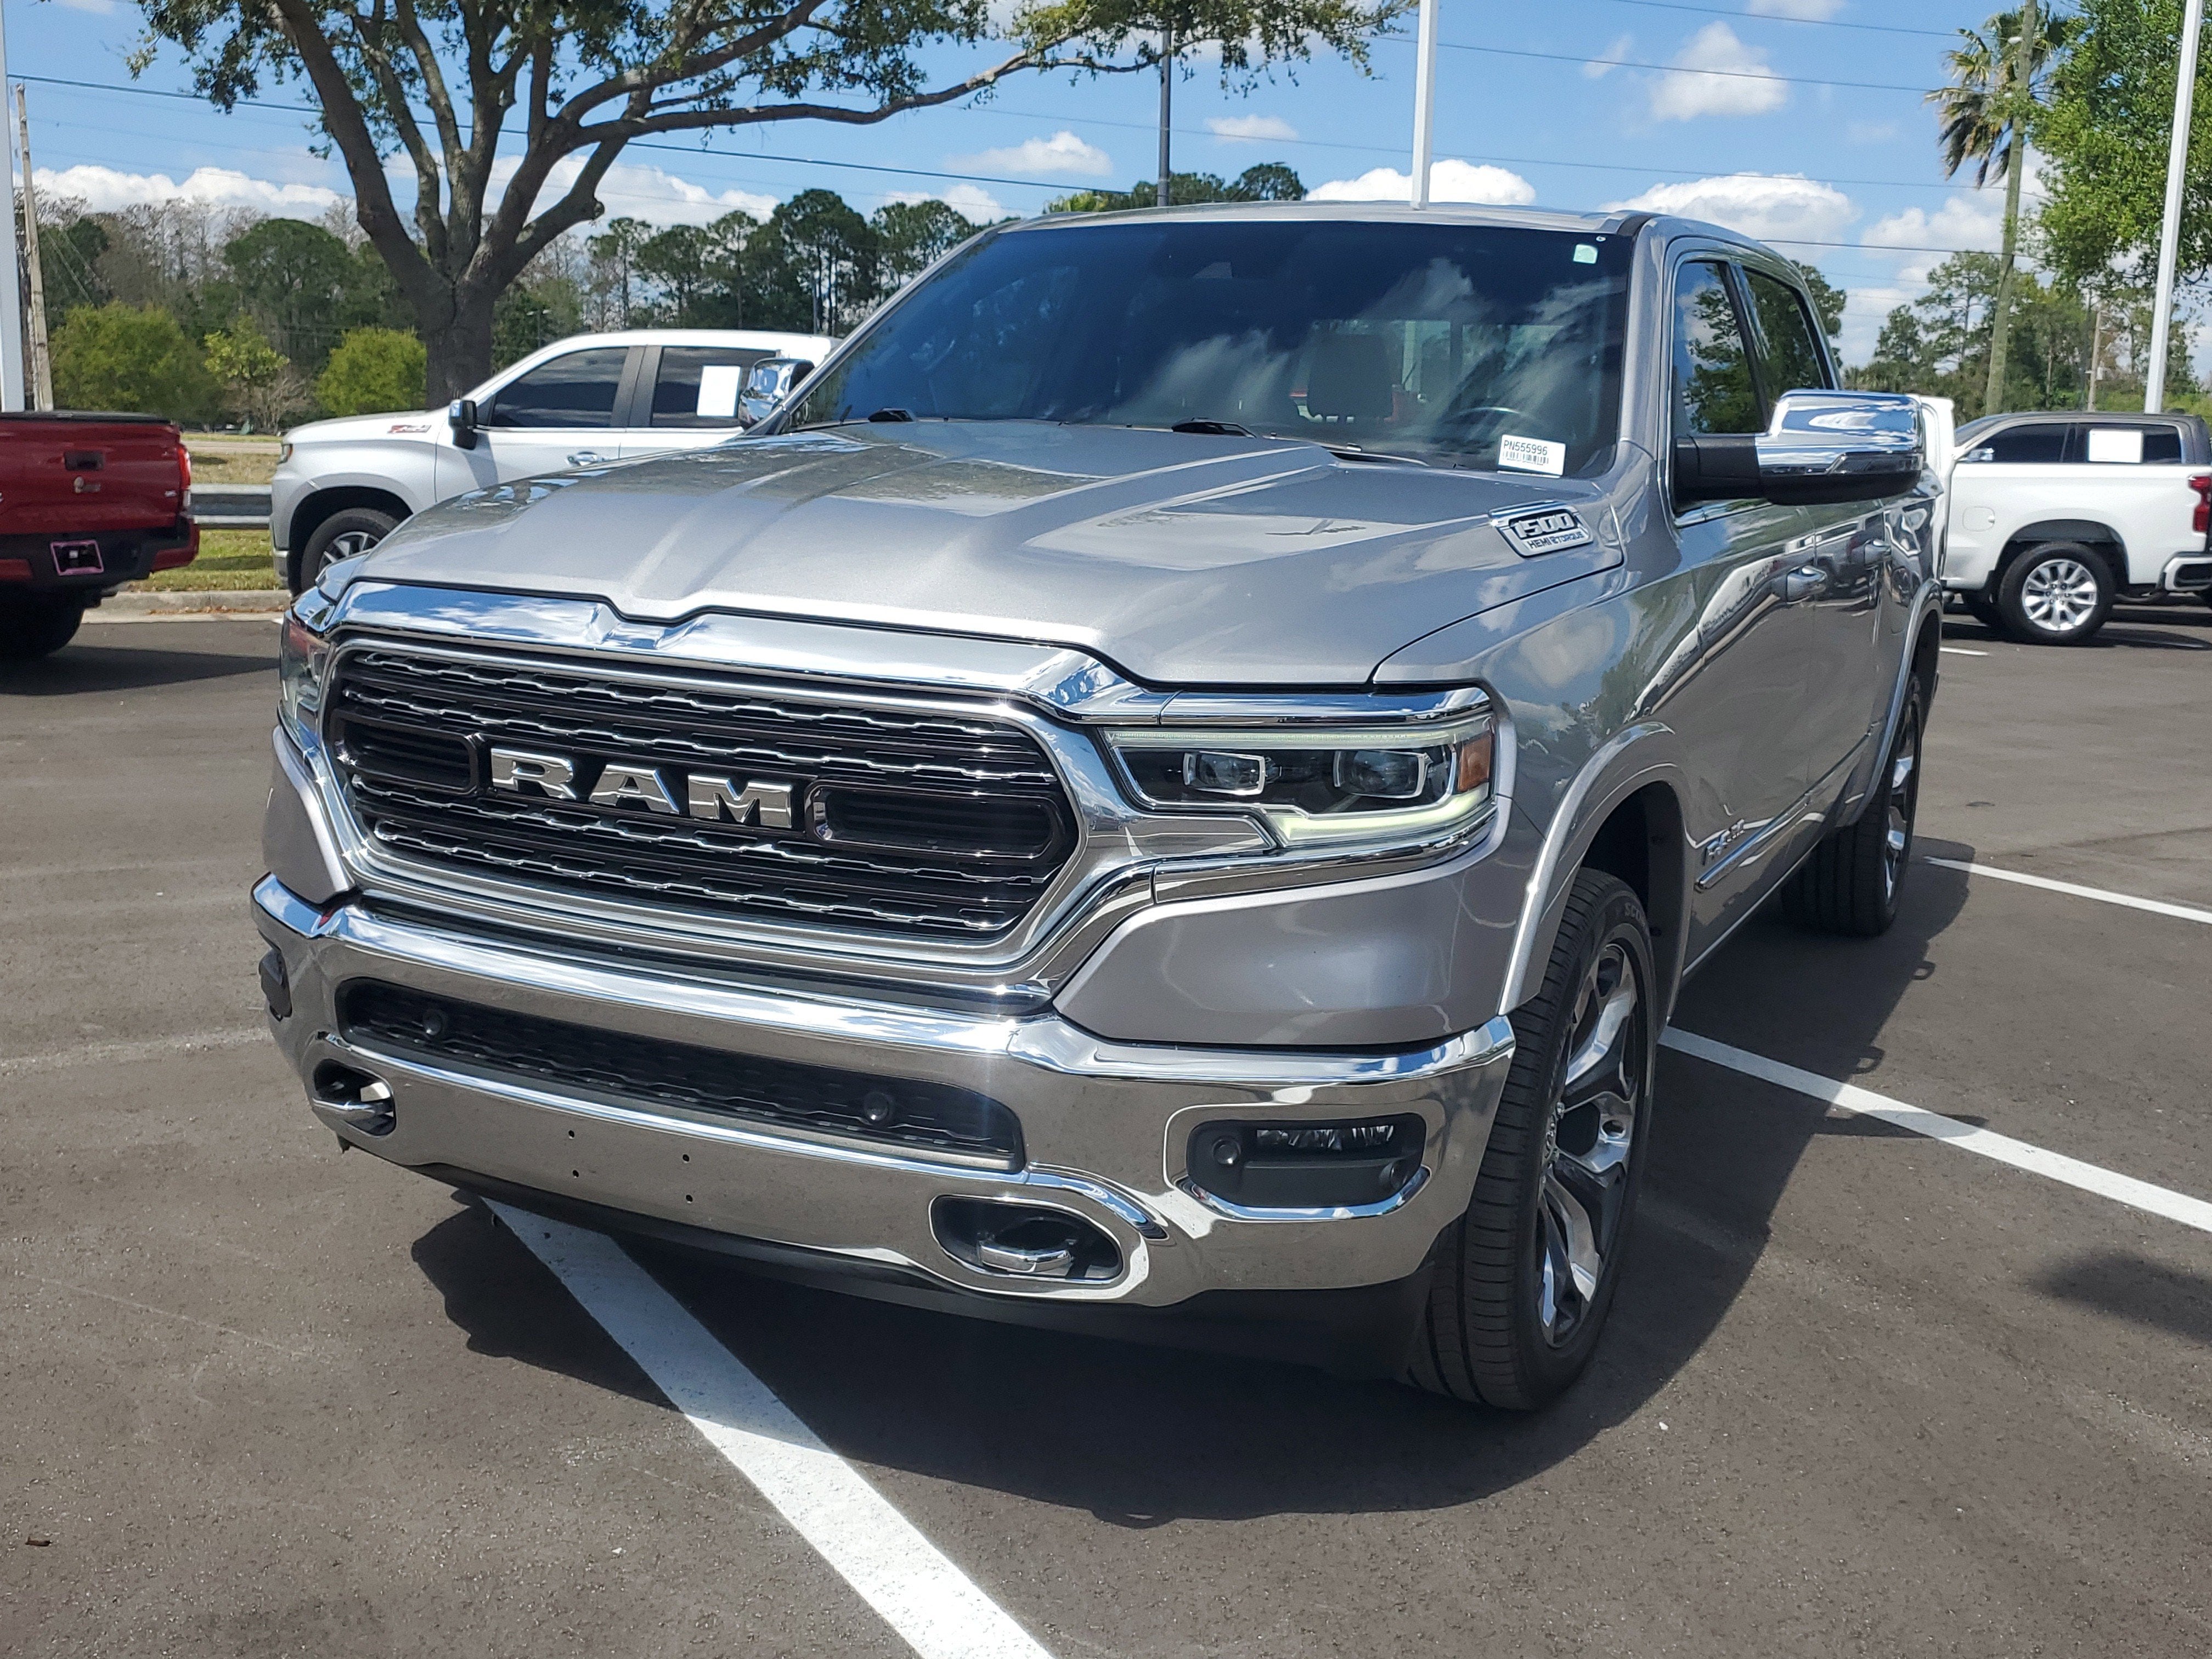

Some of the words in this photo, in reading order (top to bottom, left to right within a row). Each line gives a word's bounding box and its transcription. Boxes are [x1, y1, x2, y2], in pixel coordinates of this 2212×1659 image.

[1504, 440, 1548, 455] PN555996
[1513, 513, 1575, 538] 1500
[1527, 538, 1551, 549] HEMI
[490, 747, 793, 829] RAM
